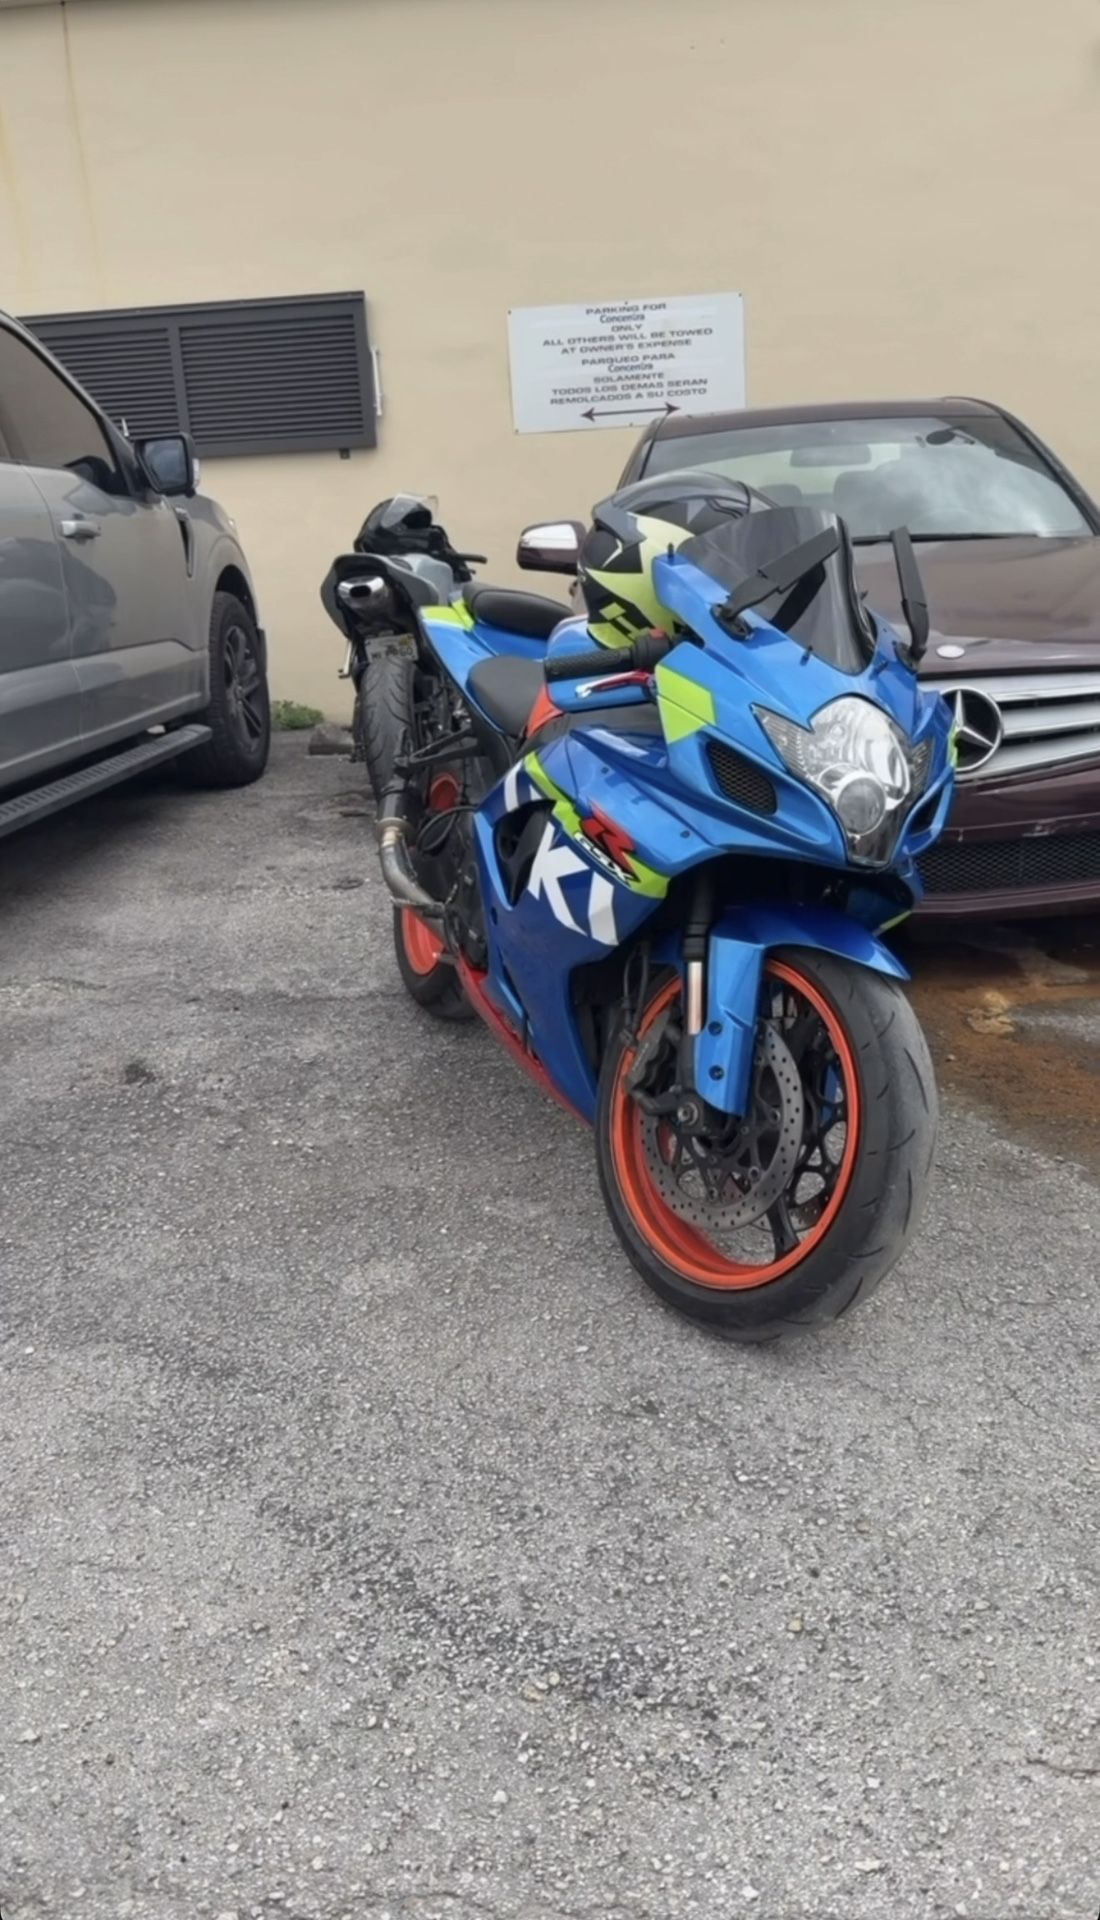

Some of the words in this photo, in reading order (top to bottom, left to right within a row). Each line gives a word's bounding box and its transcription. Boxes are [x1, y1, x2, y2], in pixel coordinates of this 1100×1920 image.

[585, 305, 639, 315] PARKING
[643, 302, 666, 311] FOR
[611, 324, 642, 332] ONLY
[543, 339, 564, 347] ALL
[567, 335, 615, 345] OTHERS
[618, 332, 647, 341] WILL
[650, 331, 665, 339] BE
[669, 327, 713, 337] TOWED
[561, 347, 576, 355] AT
[579, 343, 634, 354] OWNER'S
[637, 338, 692, 349] EXPENSE
[581, 355, 639, 366] PARQUEO
[642, 353, 675, 361] PARA
[593, 372, 664, 384] SOLAMENTE
[552, 387, 592, 396] TODOS
[595, 385, 618, 393] LOS
[621, 381, 664, 391] DEMAS
[667, 378, 708, 387] SERAN
[550, 393, 632, 405] REMOLCADOS
[647, 391, 664, 399] SU
[667, 388, 708, 397] COSTO
